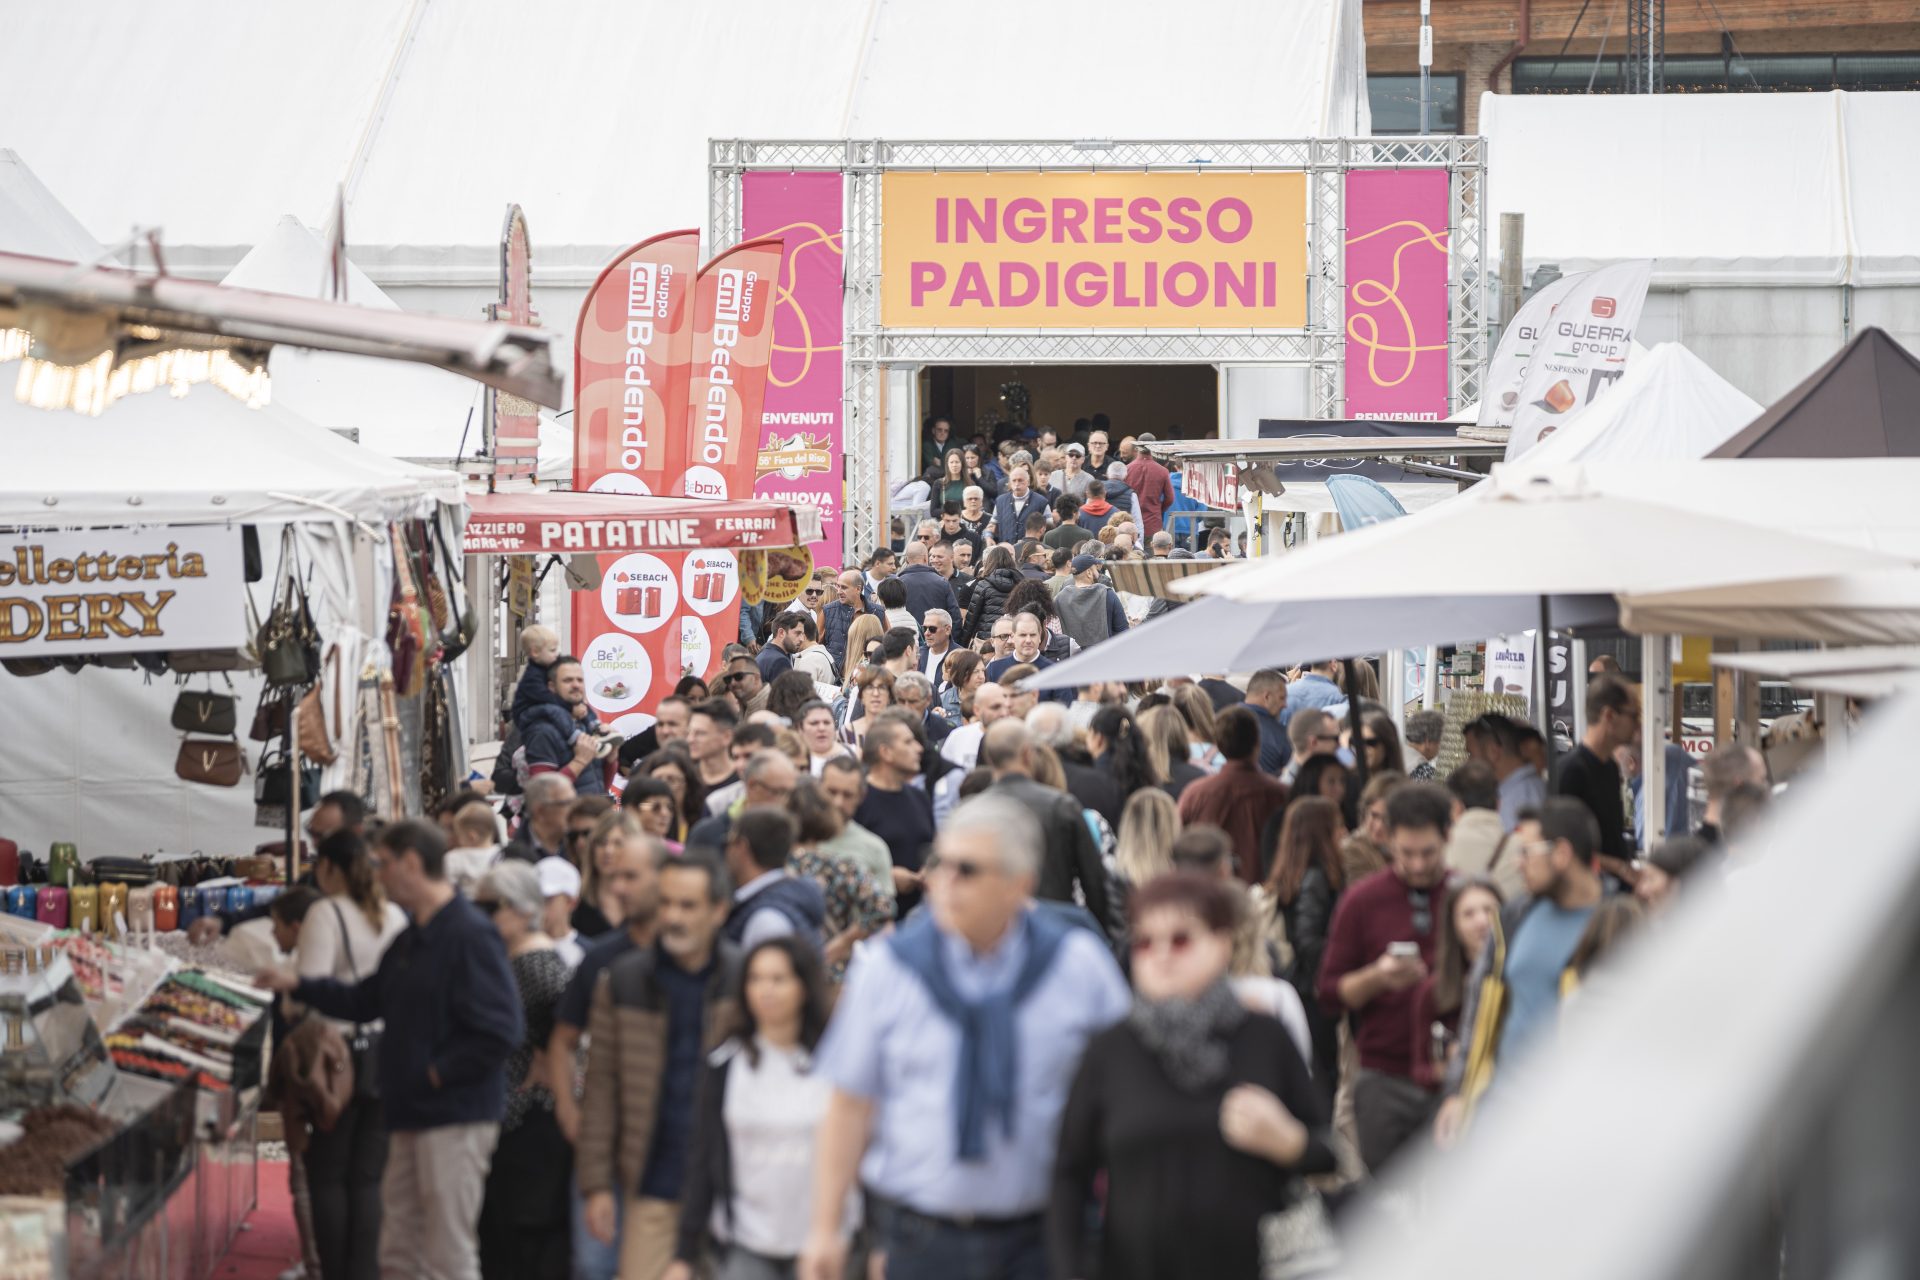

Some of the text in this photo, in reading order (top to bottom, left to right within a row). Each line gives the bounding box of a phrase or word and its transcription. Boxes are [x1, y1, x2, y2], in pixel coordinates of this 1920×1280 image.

[936, 197, 1253, 244] INGRESSO
[656, 264, 672, 318] Gruppo
[910, 261, 1277, 307] PADIGLIONI
[742, 270, 757, 322] Gruppo
[1558, 321, 1632, 342] GUERRA
[1572, 342, 1618, 356] group
[1544, 362, 1588, 376] NESPRESSO
[621, 320, 653, 470] Bedendo
[703, 322, 739, 464] Bedendo
[774, 455, 794, 465] Fiera
[809, 453, 826, 463] Riso
[773, 492, 833, 504] NUOVA
[715, 517, 776, 530] FERRARI
[540, 519, 702, 548] PATATINE
[706, 560, 733, 569] SEBACH
[630, 573, 668, 582] SEBACH
[0, 590, 176, 643] DERY
[1495, 648, 1525, 662] LAVAZZA
[591, 658, 638, 671] Compost
